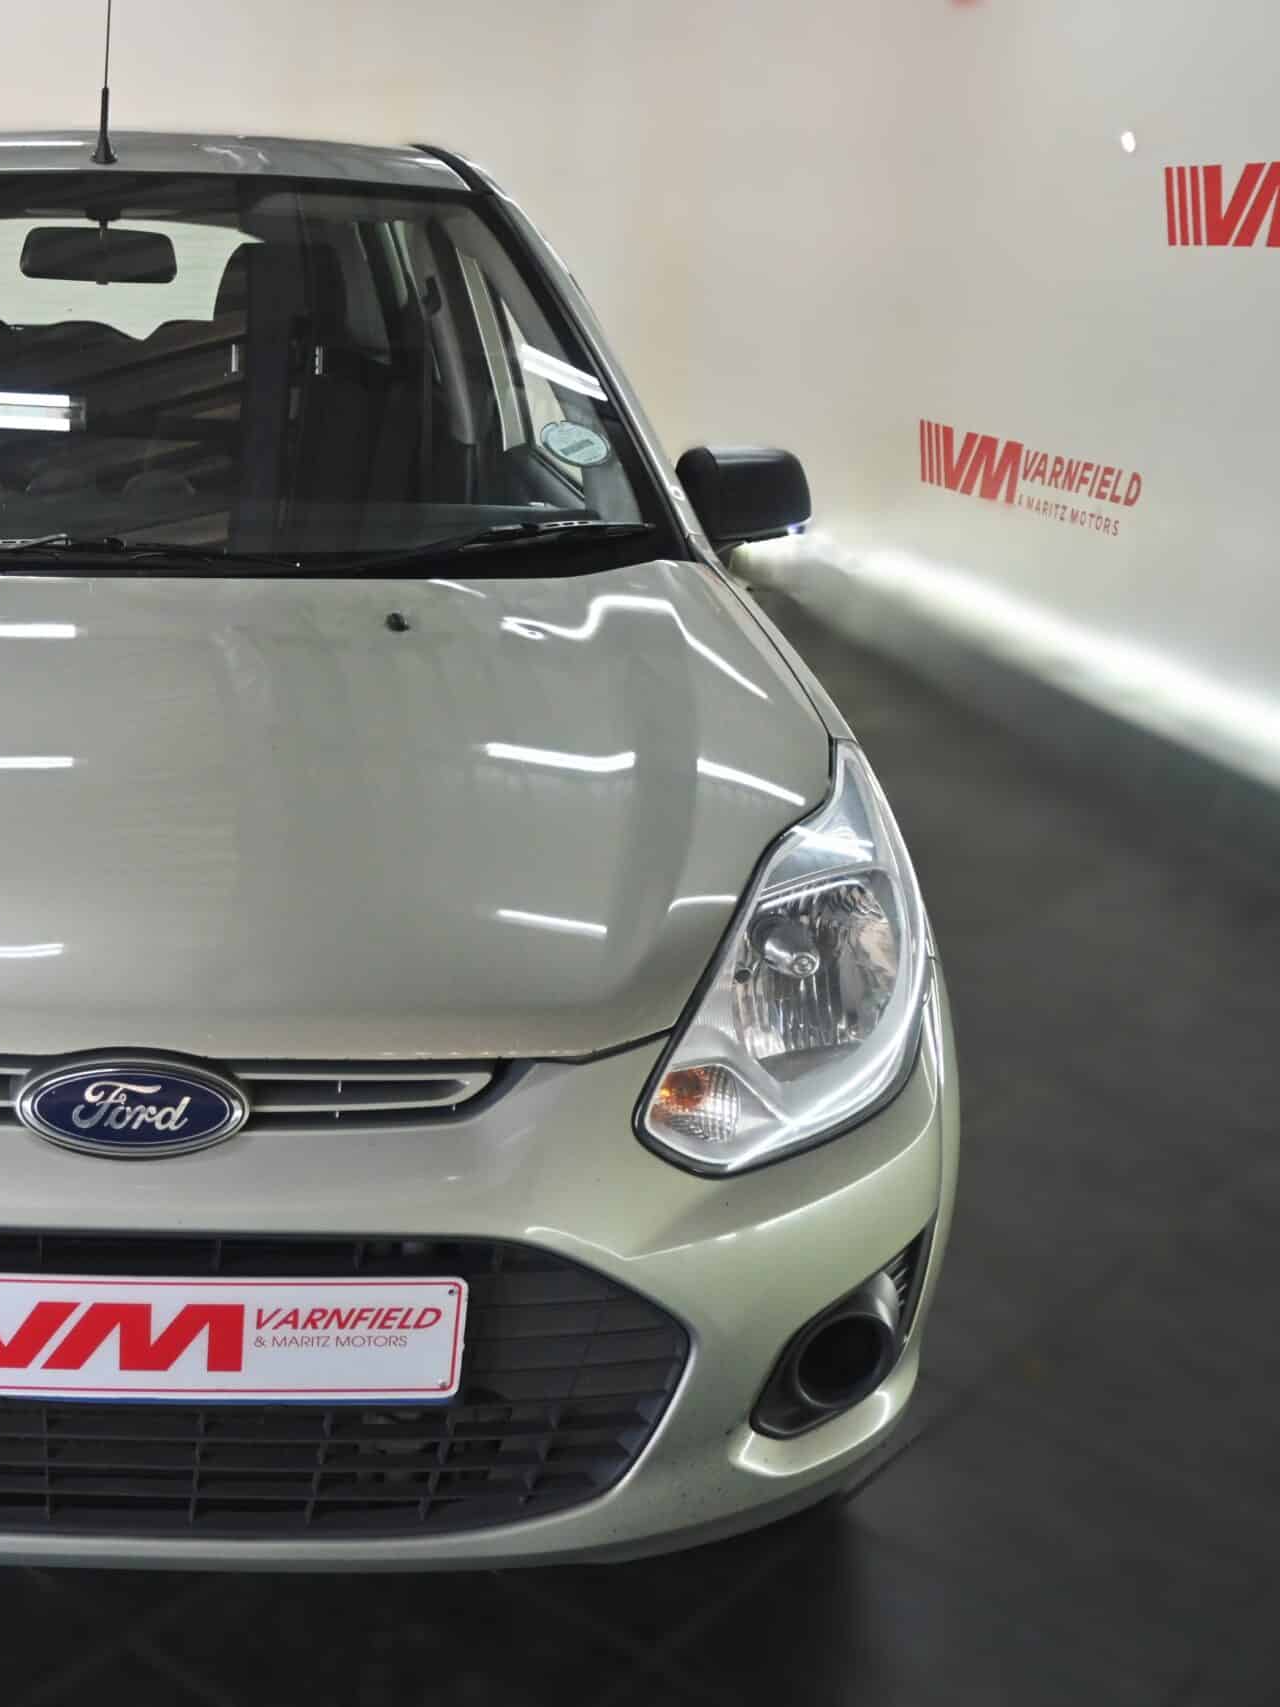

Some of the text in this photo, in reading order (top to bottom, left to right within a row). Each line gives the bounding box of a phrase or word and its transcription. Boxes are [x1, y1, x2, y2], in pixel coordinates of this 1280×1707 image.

[942, 424, 1024, 504] VM
[1022, 449, 1142, 507] VARNFIELD
[1070, 507, 1120, 536] MOTORS
[71, 1081, 192, 1131] Ford
[255, 1307, 442, 1330] VARNFIELD
[253, 1335, 408, 1349] & MARITZ MOTORS
